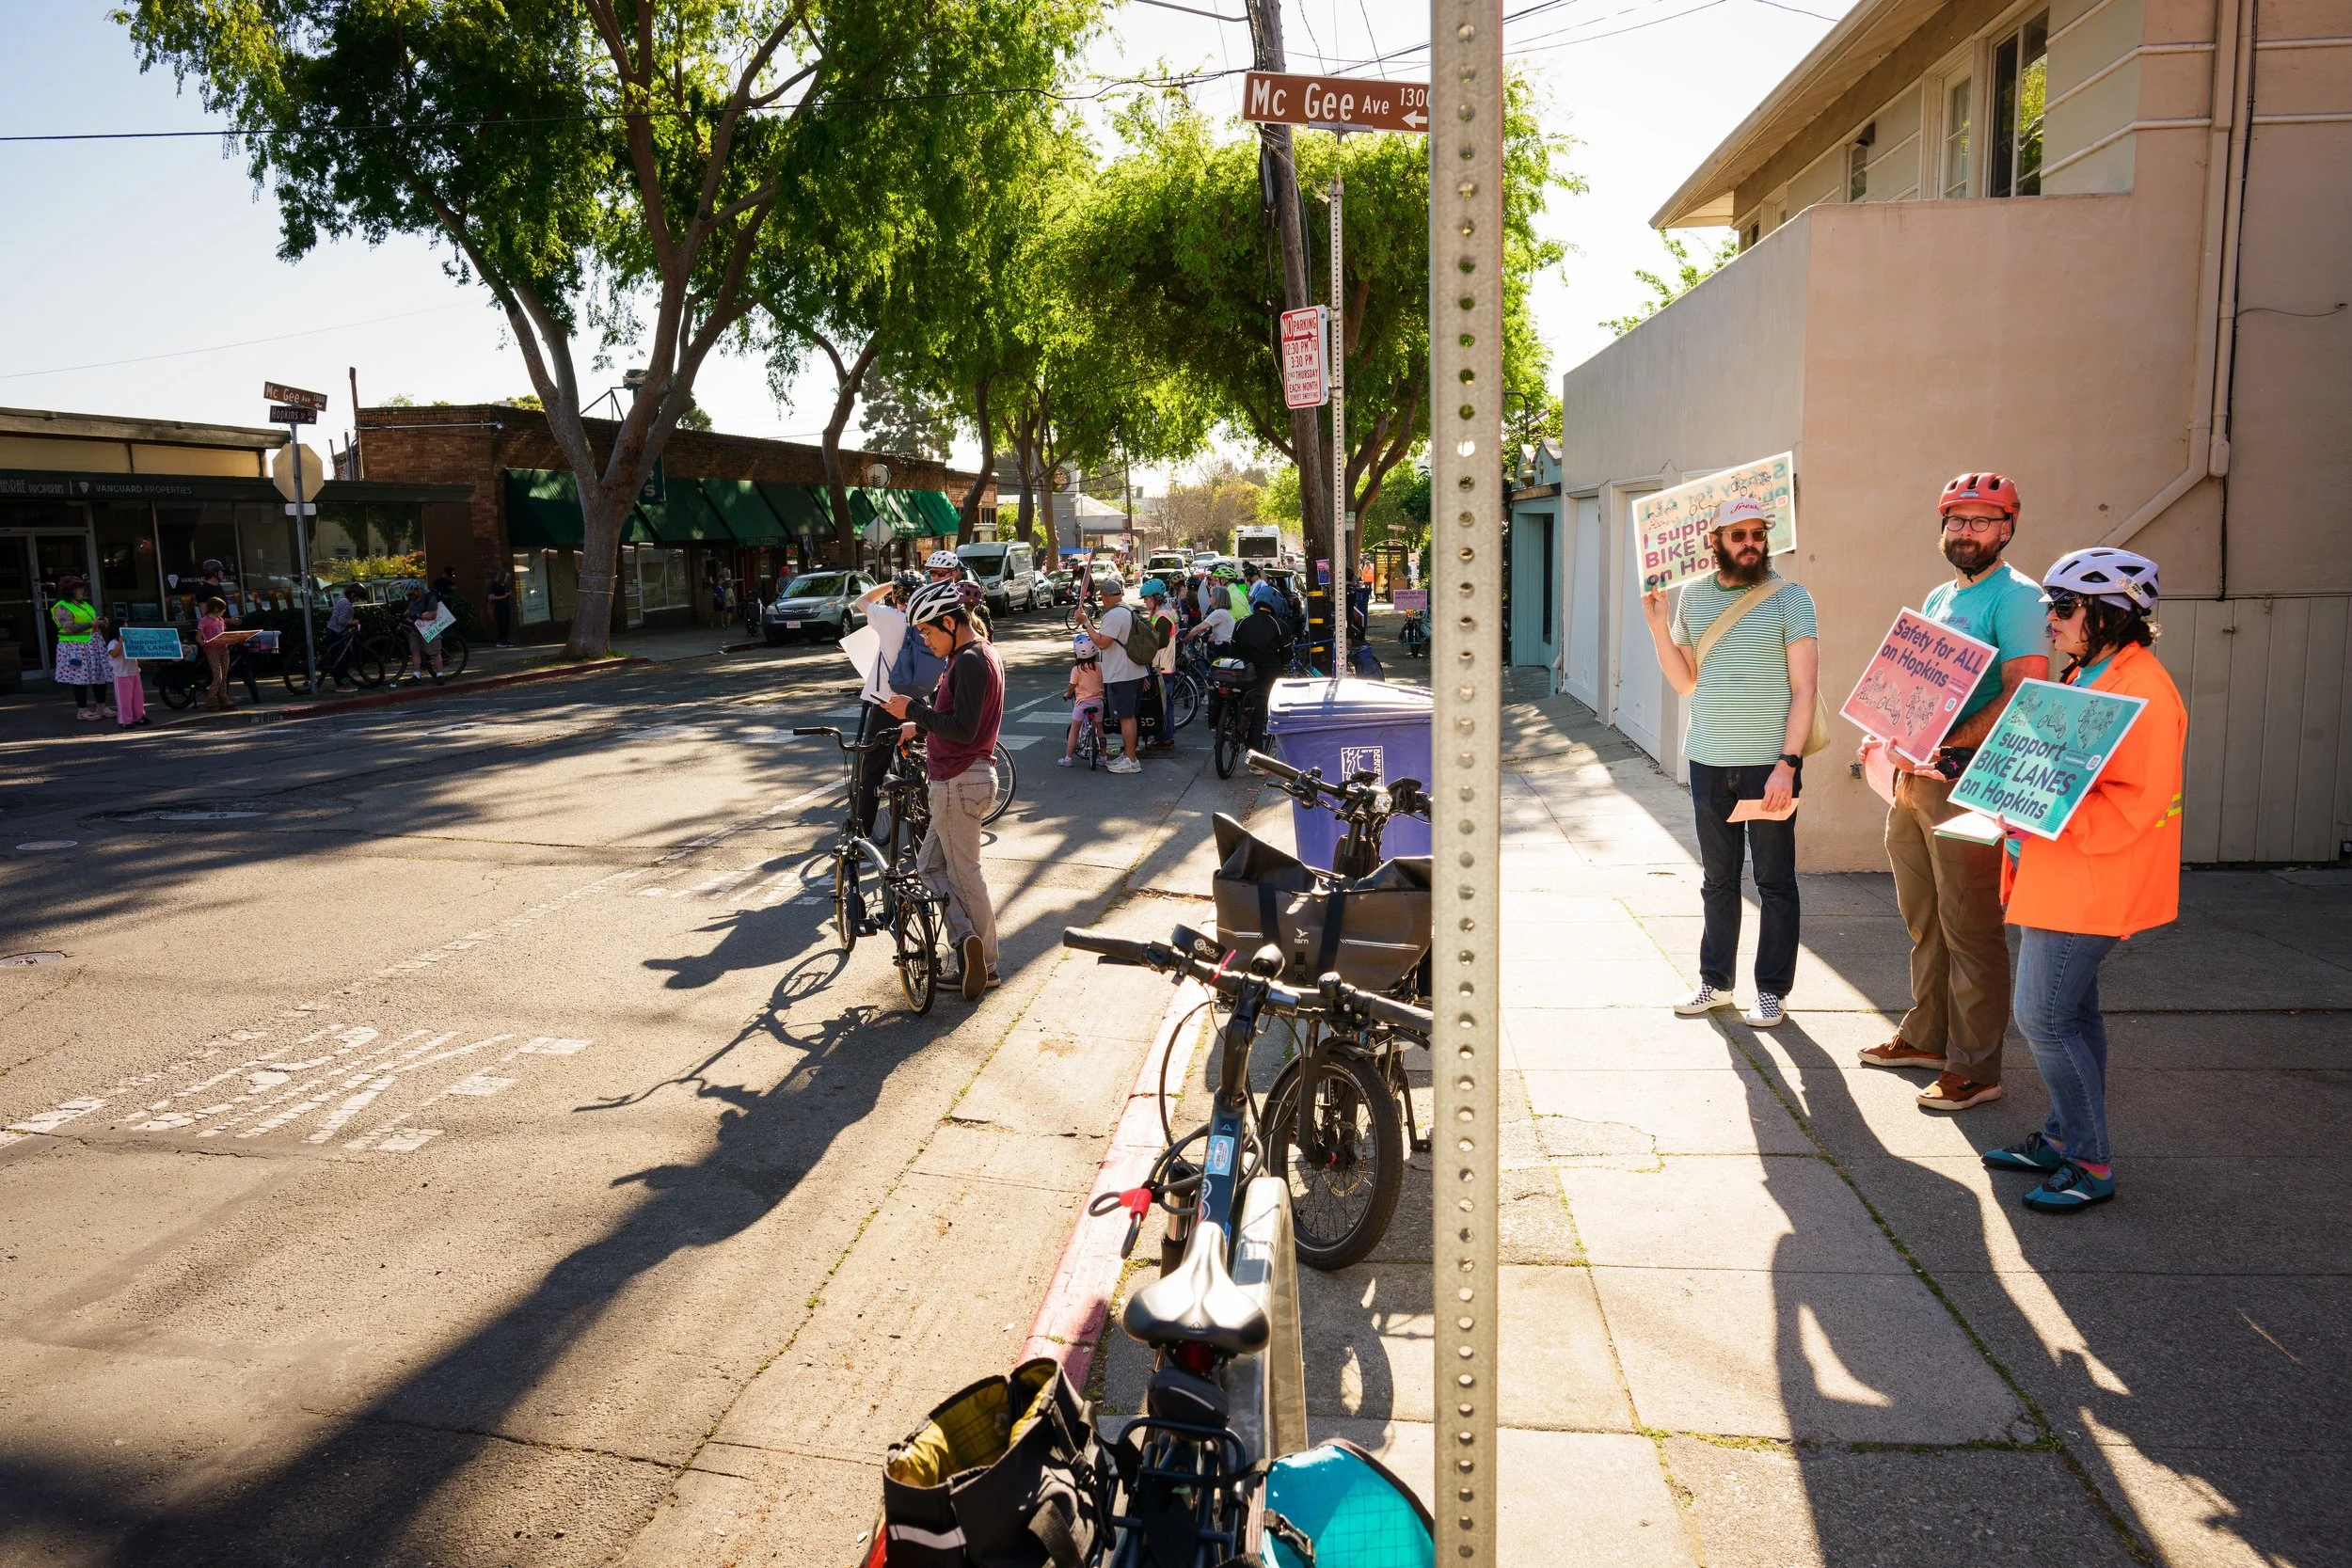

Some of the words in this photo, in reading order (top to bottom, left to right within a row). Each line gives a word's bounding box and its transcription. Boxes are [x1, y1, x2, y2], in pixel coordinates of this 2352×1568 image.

[1250, 78, 1287, 117] Mc
[1304, 82, 1355, 121] Gee
[1361, 95, 1390, 115] Ave
[1282, 317, 1293, 339] NO
[1294, 317, 1316, 332] PARKING
[1285, 342, 1298, 356] 12:30
[1301, 341, 1309, 353] PM
[1311, 339, 1317, 351] TO
[1291, 356, 1303, 369] 3:30
[1305, 354, 1313, 366] PM
[1287, 372, 1295, 381] 2ND
[1295, 369, 1318, 380] THURSDAY
[265, 384, 278, 399] Mc
[283, 388, 300, 404] Gee
[301, 395, 311, 404] Ave
[313, 394, 326, 404] 1300
[1289, 383, 1301, 393] EACH
[1303, 381, 1318, 391] MONTH
[1302, 391, 1318, 400] SWEEPING
[271, 406, 298, 421] Hopkins
[95, 483, 143, 494] VANGUARD
[144, 485, 192, 495] PROPERTIES
[1730, 502, 1760, 515] fresh
[1643, 533, 1649, 549] I
[1657, 517, 1712, 546] supp
[1645, 538, 1696, 569] BIKE
[1646, 567, 1673, 586] on
[1893, 618, 1934, 654] Safety
[1932, 637, 1956, 659] for
[1953, 647, 1984, 675] ALL
[1881, 644, 1898, 661] on
[1897, 647, 1949, 688] Hopkins
[1104, 718, 1120, 727] GS
[1139, 717, 1155, 727] SD
[1989, 724, 2003, 744] I
[1998, 732, 2068, 762] support
[1973, 750, 2017, 778] BIKE
[2011, 760, 2077, 796] LANES
[1959, 778, 1981, 797] on
[1979, 779, 2048, 819] Hopkins
